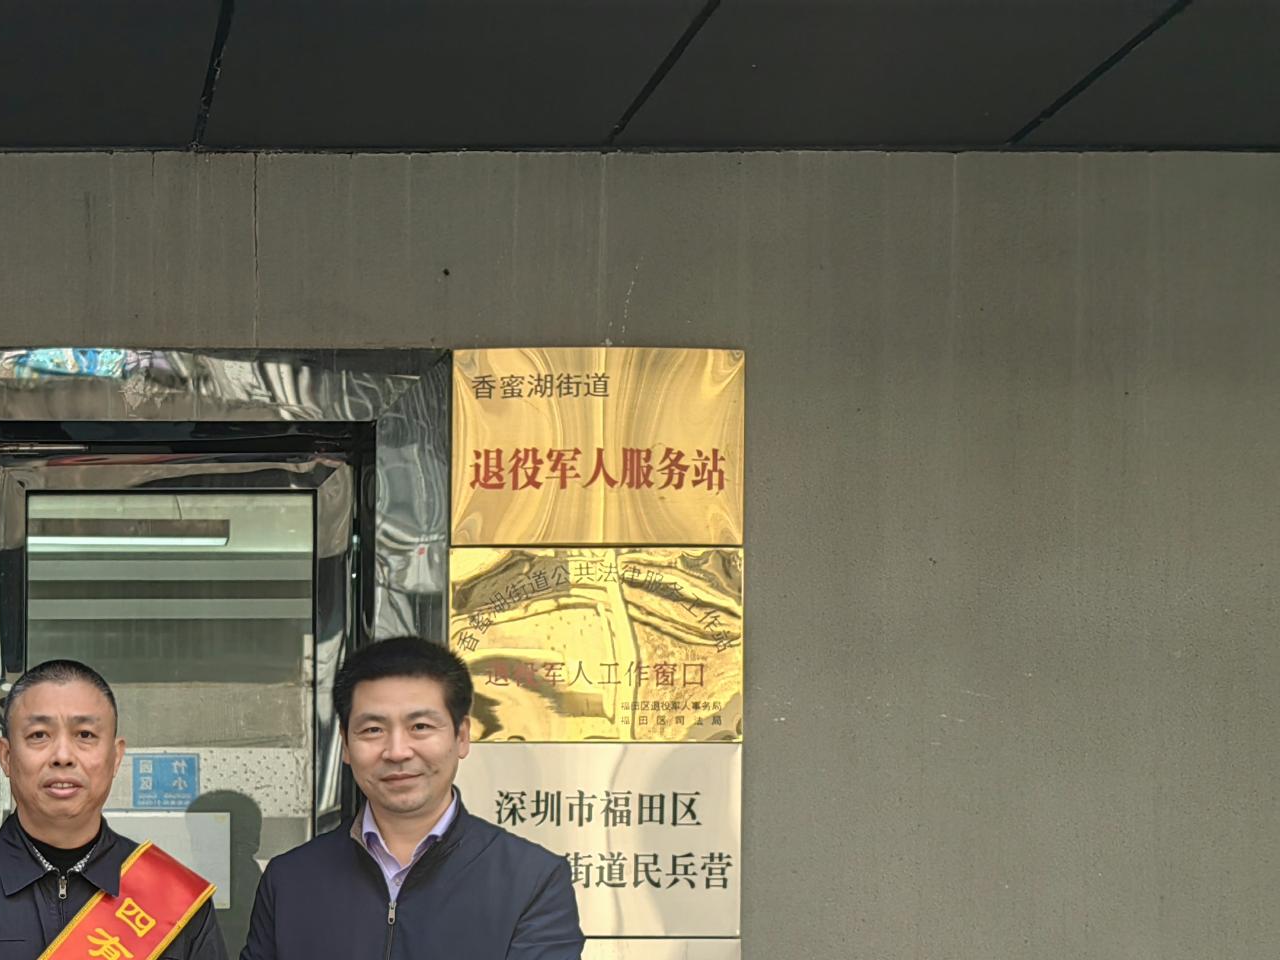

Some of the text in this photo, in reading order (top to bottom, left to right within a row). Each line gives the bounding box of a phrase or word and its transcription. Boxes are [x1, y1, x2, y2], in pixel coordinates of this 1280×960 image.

[471, 373, 610, 399] 香蜜湖街道
[470, 447, 726, 490] 退役军人服务站
[457, 562, 733, 652] 香蜜湖街道公共法律服务工作站
[485, 661, 705, 687] 退役军人工作窗口
[495, 790, 701, 827] 深圳市福田区
[565, 852, 733, 889] 街道民兵营
